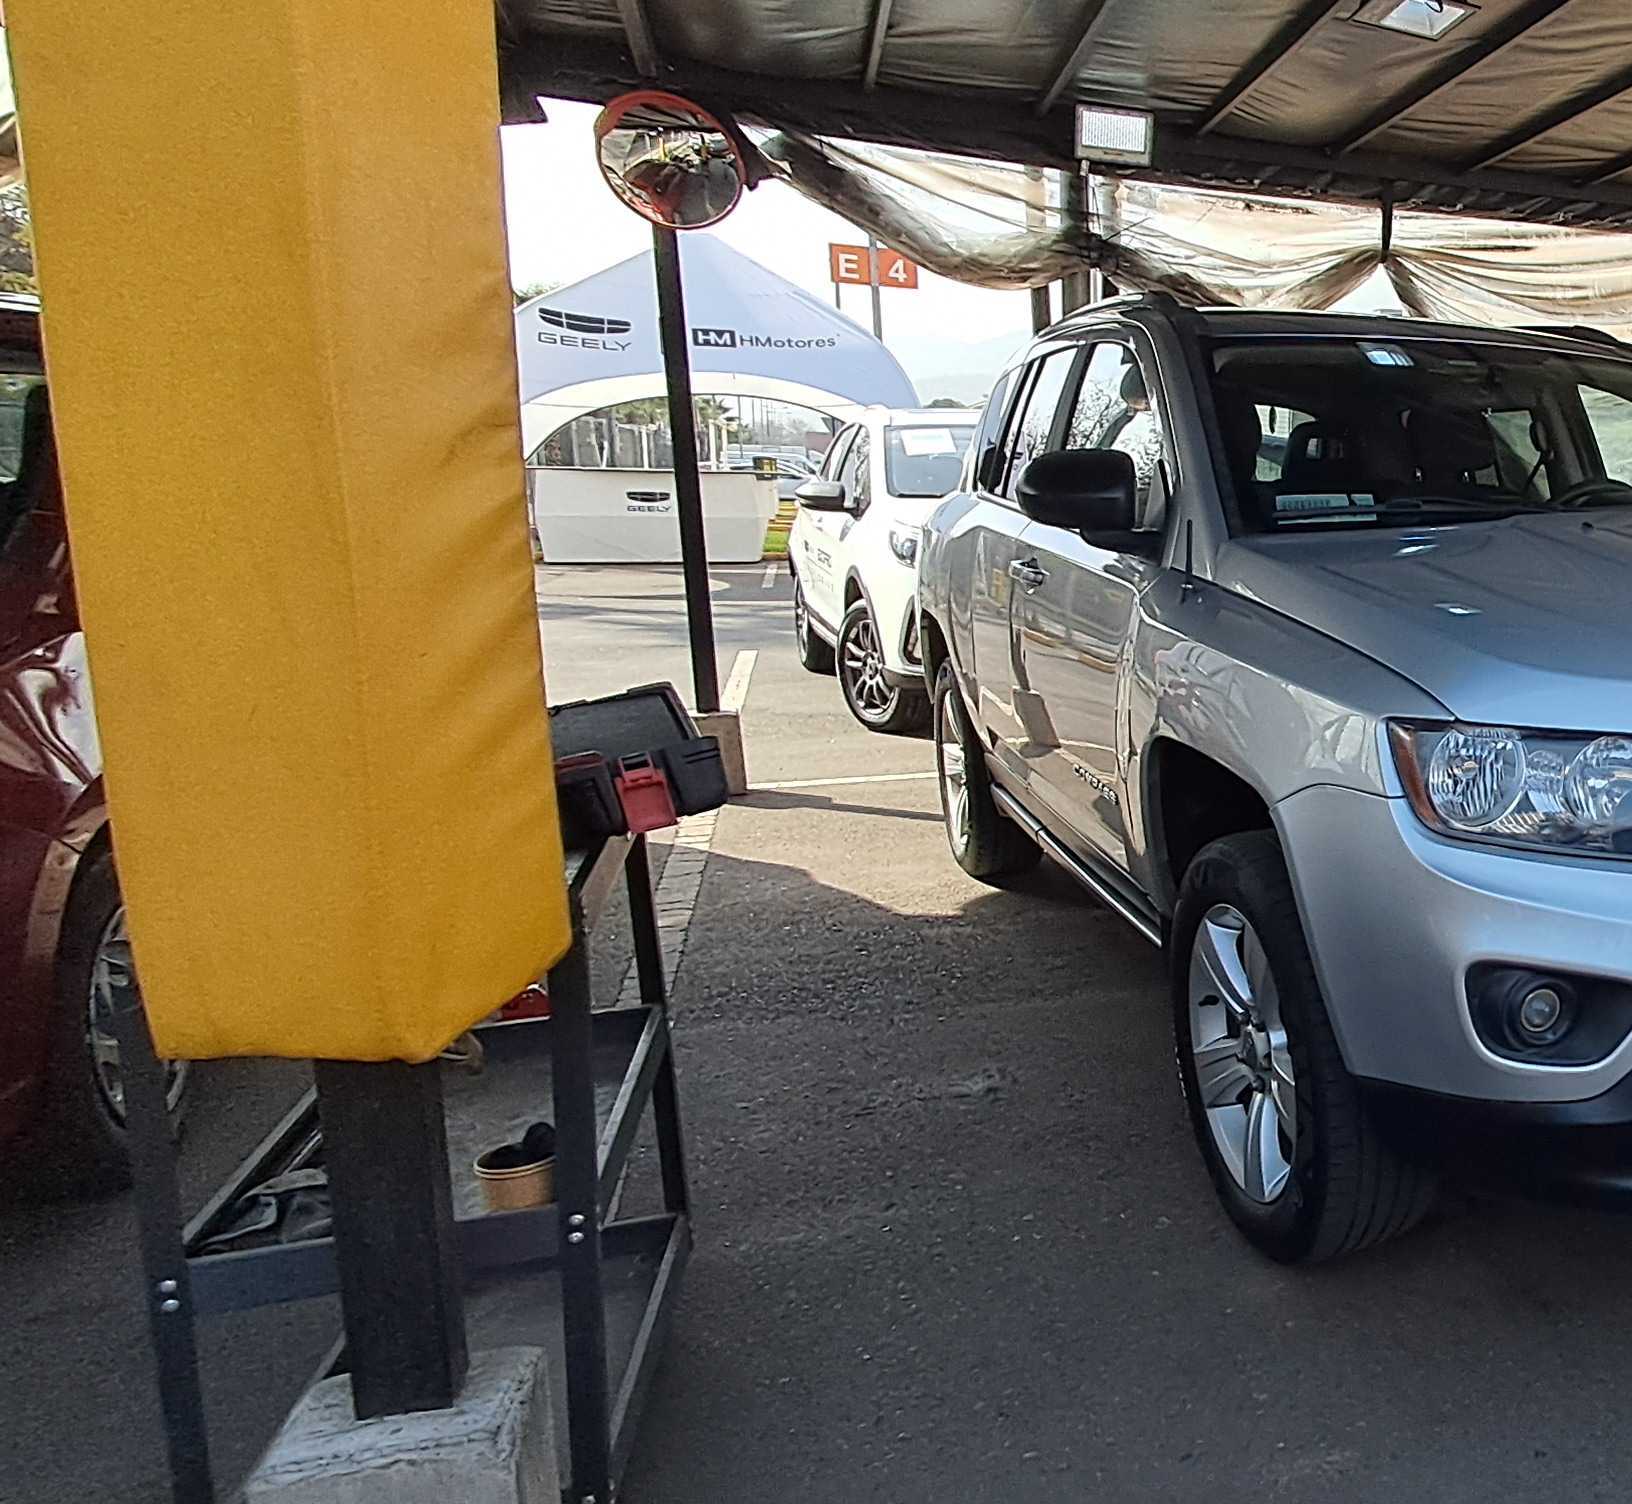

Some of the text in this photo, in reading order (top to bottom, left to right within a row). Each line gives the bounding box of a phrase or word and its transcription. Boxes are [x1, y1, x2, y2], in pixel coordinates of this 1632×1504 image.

[838, 252, 908, 283] E 4
[537, 331, 632, 352] GEELY
[696, 330, 837, 349] HM HMotores
